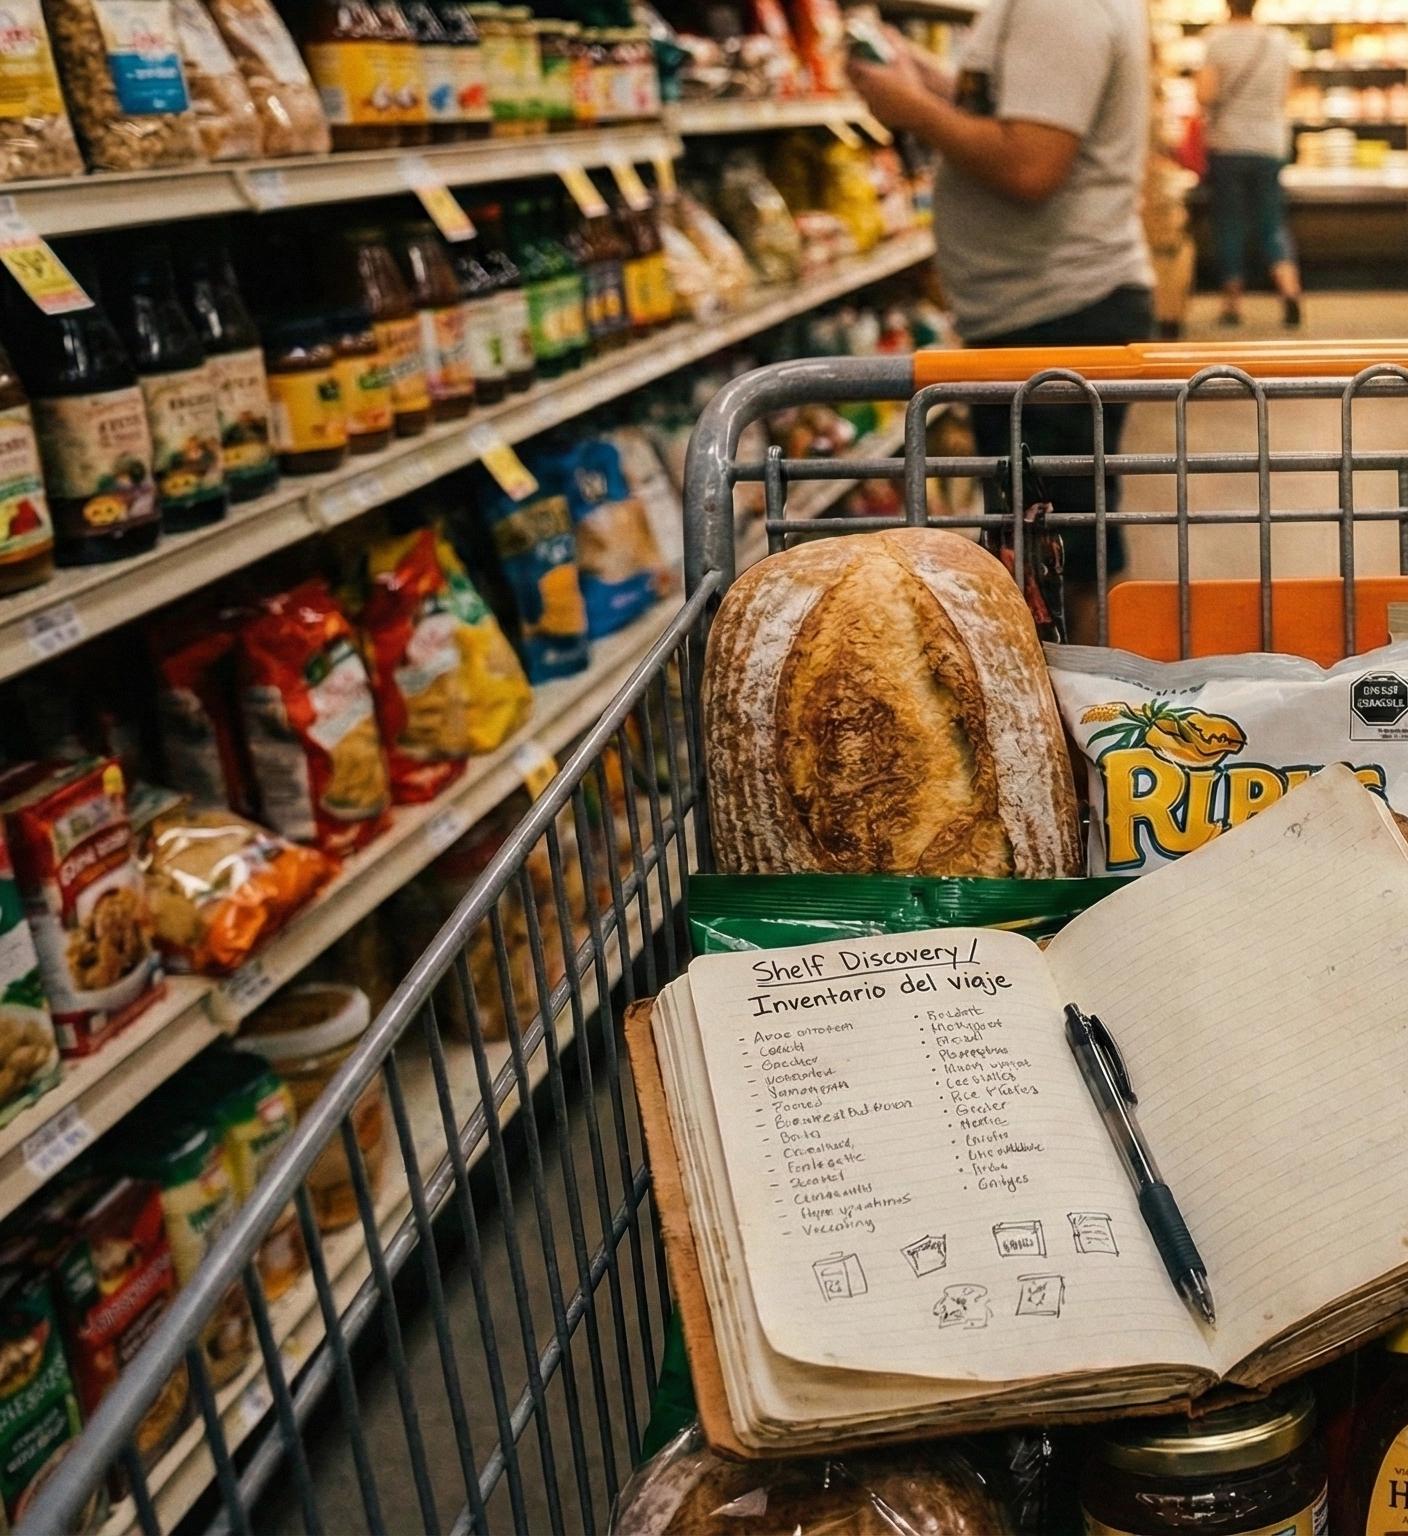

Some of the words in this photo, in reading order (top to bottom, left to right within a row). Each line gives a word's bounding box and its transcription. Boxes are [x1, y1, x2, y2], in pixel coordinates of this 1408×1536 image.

[752, 955, 825, 983] Shelf
[748, 983, 886, 1017] Inventario
[900, 973, 937, 994] del
[947, 971, 1012, 996] viaje
